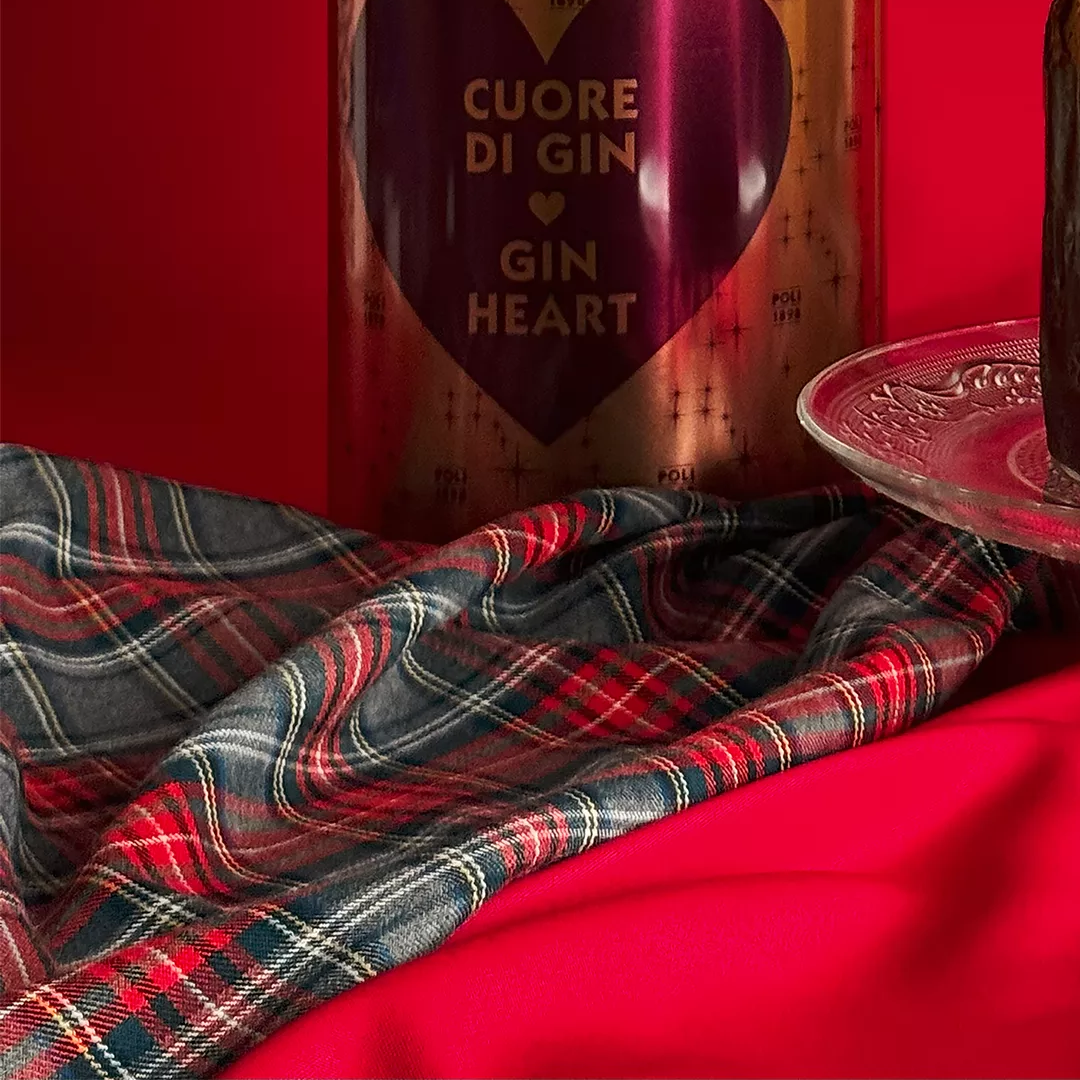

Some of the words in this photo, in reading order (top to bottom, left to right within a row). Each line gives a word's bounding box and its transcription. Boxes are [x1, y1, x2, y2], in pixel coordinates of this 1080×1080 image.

[463, 78, 639, 121] CUORE
[466, 131, 513, 175] DI
[536, 131, 636, 175] GIN
[500, 239, 598, 283] GIN
[467, 291, 638, 337] HEART
[657, 467, 696, 484] POLI
